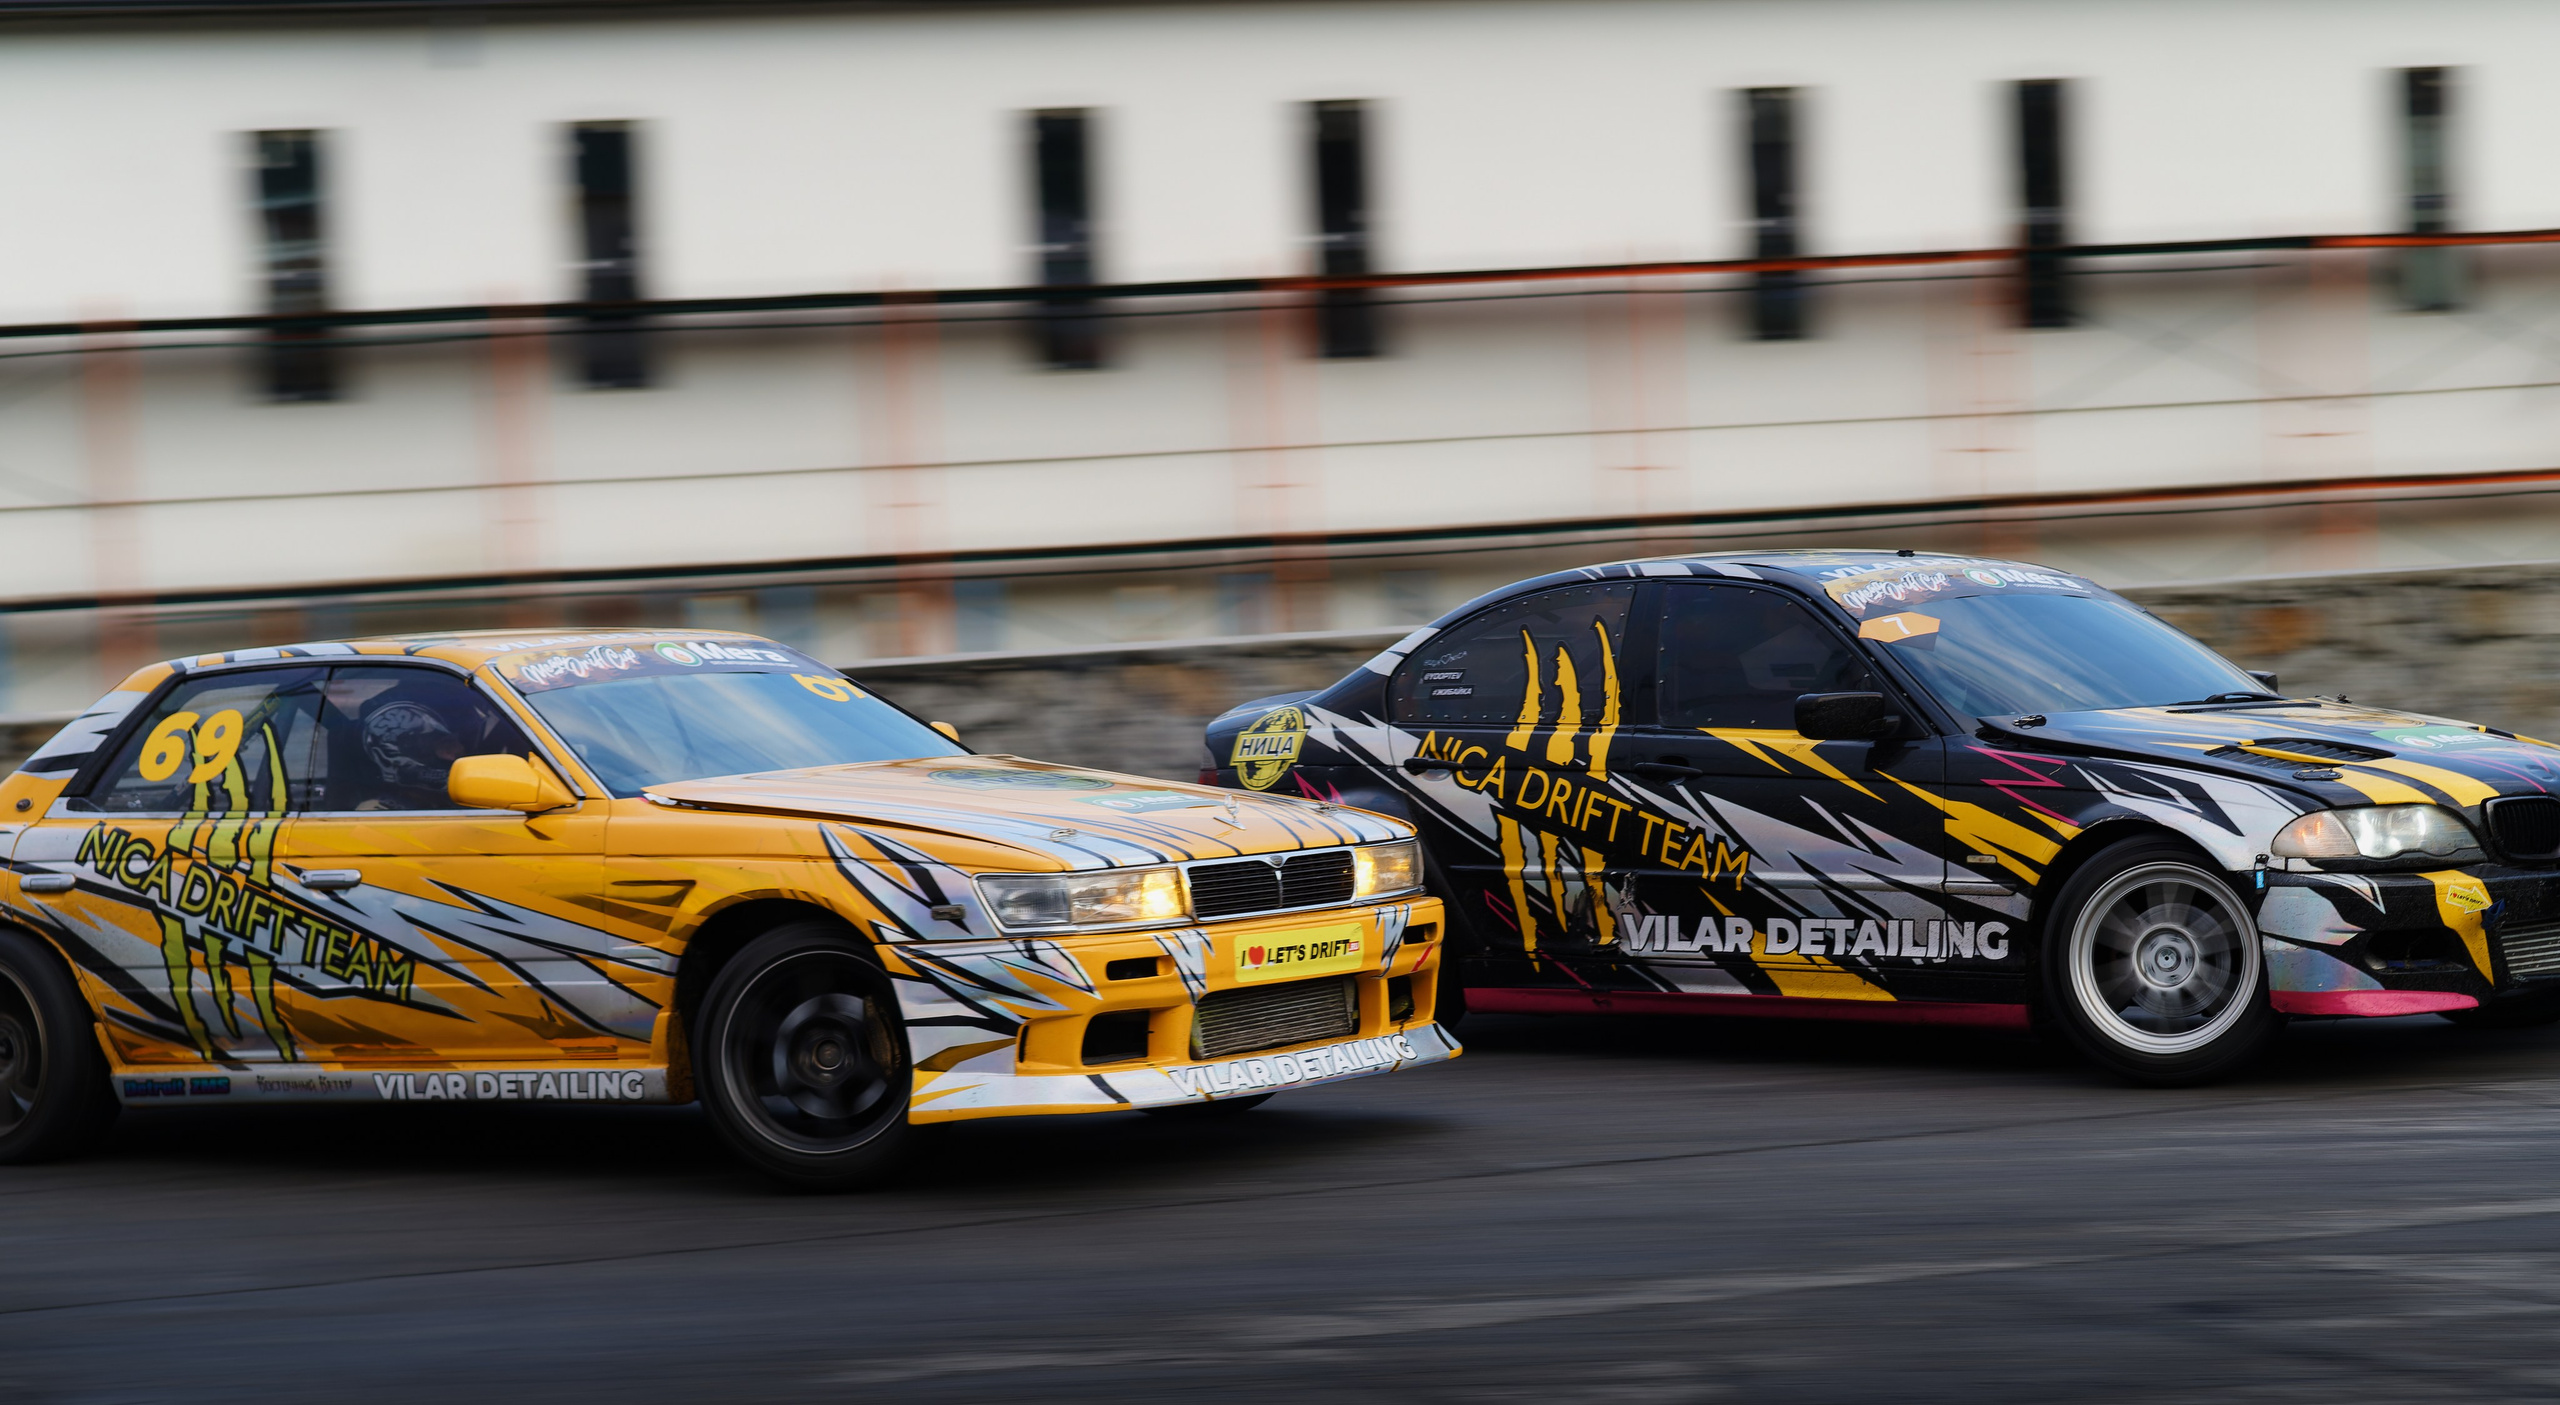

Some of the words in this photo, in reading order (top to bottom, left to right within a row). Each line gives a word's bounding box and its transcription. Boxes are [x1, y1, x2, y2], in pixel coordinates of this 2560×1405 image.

[1919, 572, 1951, 592] Cup
[1882, 616, 1911, 635] 7
[606, 646, 641, 671] Cup
[139, 709, 243, 784] 69
[1238, 736, 1294, 757] НИЦА
[1418, 730, 1506, 800] NICA
[1515, 766, 1634, 842] DRIFT
[1638, 811, 1749, 891] TEAM
[76, 822, 171, 905] NICA
[177, 862, 295, 954] DRIFT
[300, 914, 414, 1000] TEAM
[1622, 913, 1754, 954] VILAR
[1764, 916, 2010, 960] DETAILING
[1241, 950, 1246, 967] I
[1267, 944, 1306, 964] LET'S
[1310, 939, 1350, 960] DRIFT
[1168, 1058, 1274, 1097] VILAR
[1274, 1034, 1418, 1082] DETAILING
[373, 1072, 467, 1100] VILAR
[475, 1070, 645, 1100] DETAILING
